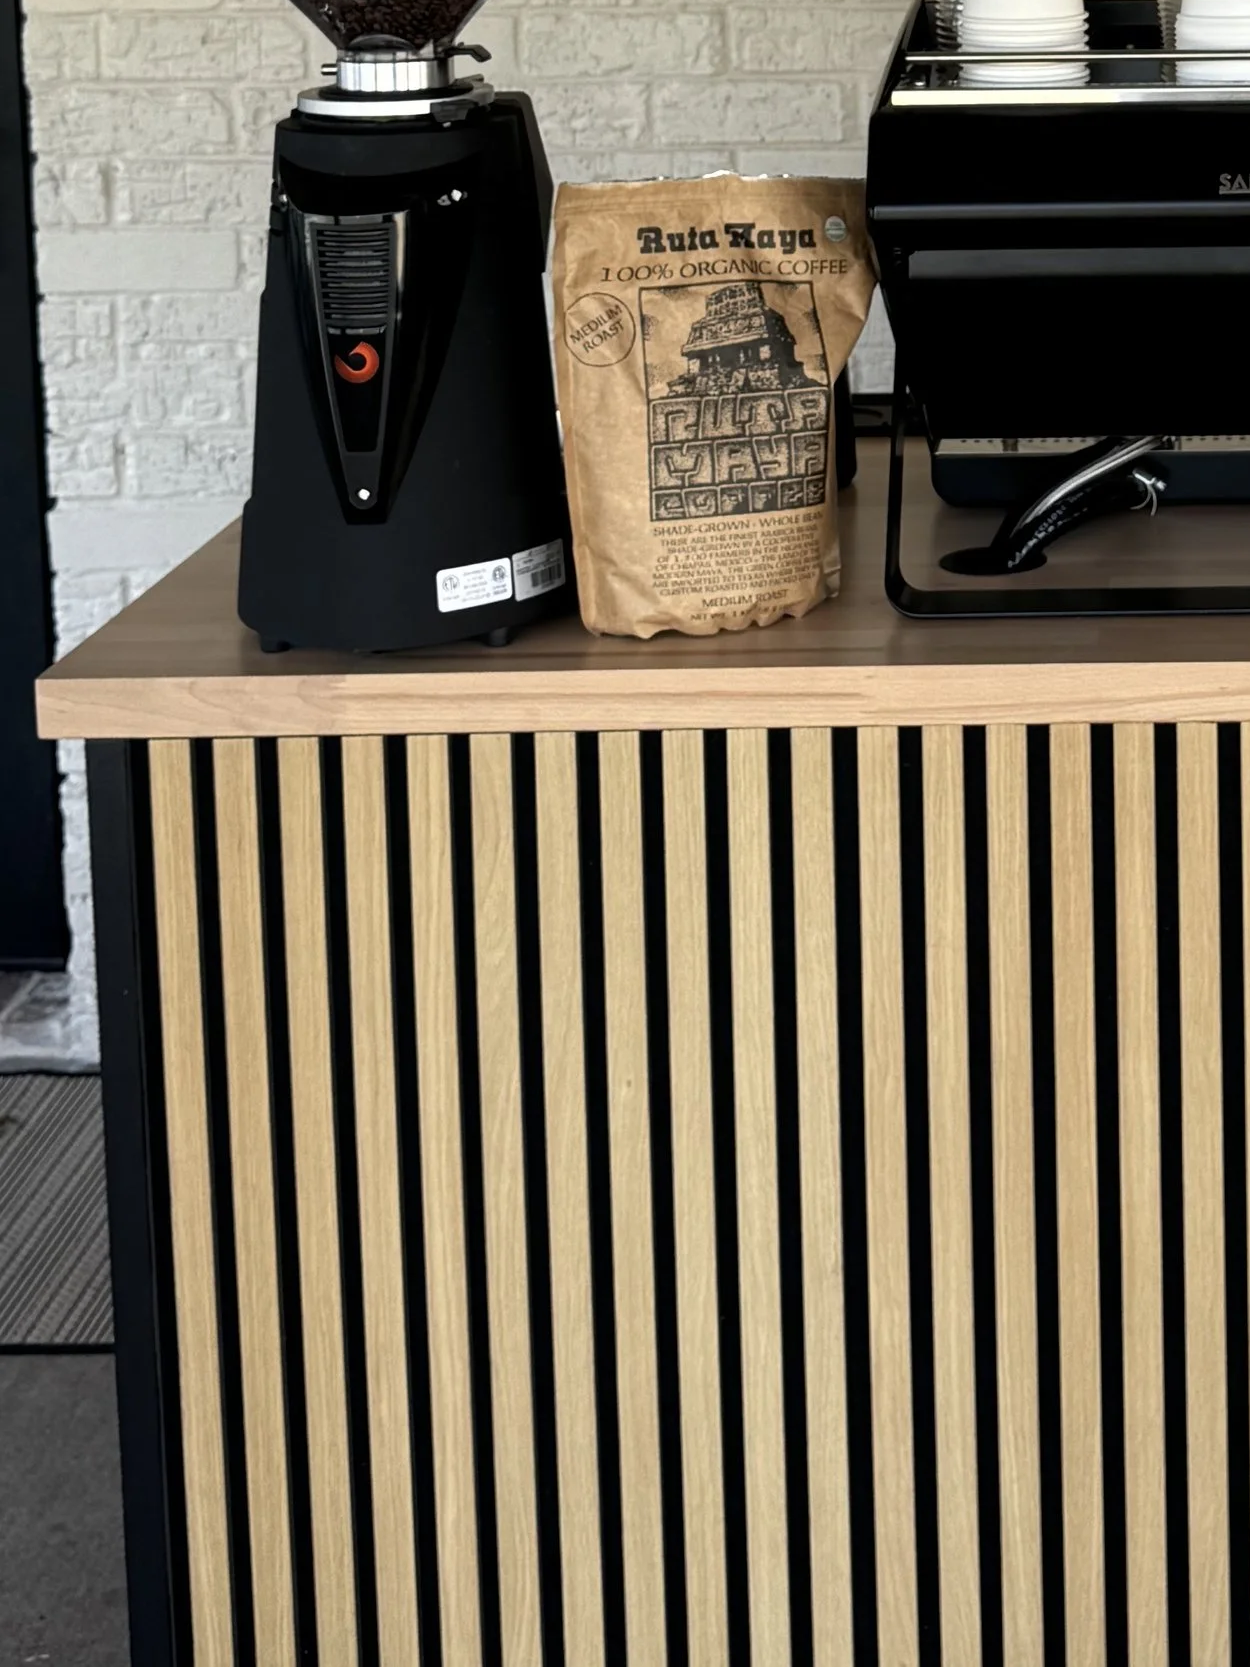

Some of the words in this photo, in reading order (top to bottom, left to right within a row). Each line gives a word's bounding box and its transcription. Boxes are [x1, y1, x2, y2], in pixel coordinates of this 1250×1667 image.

[636, 226, 719, 254] Ruta
[600, 263, 673, 282] 100%
[680, 259, 772, 278] ORGANIC
[777, 259, 848, 276] COFFEE
[570, 304, 623, 344] MEDIUM
[583, 318, 624, 353] ROAST
[702, 594, 752, 608] MEDIUM
